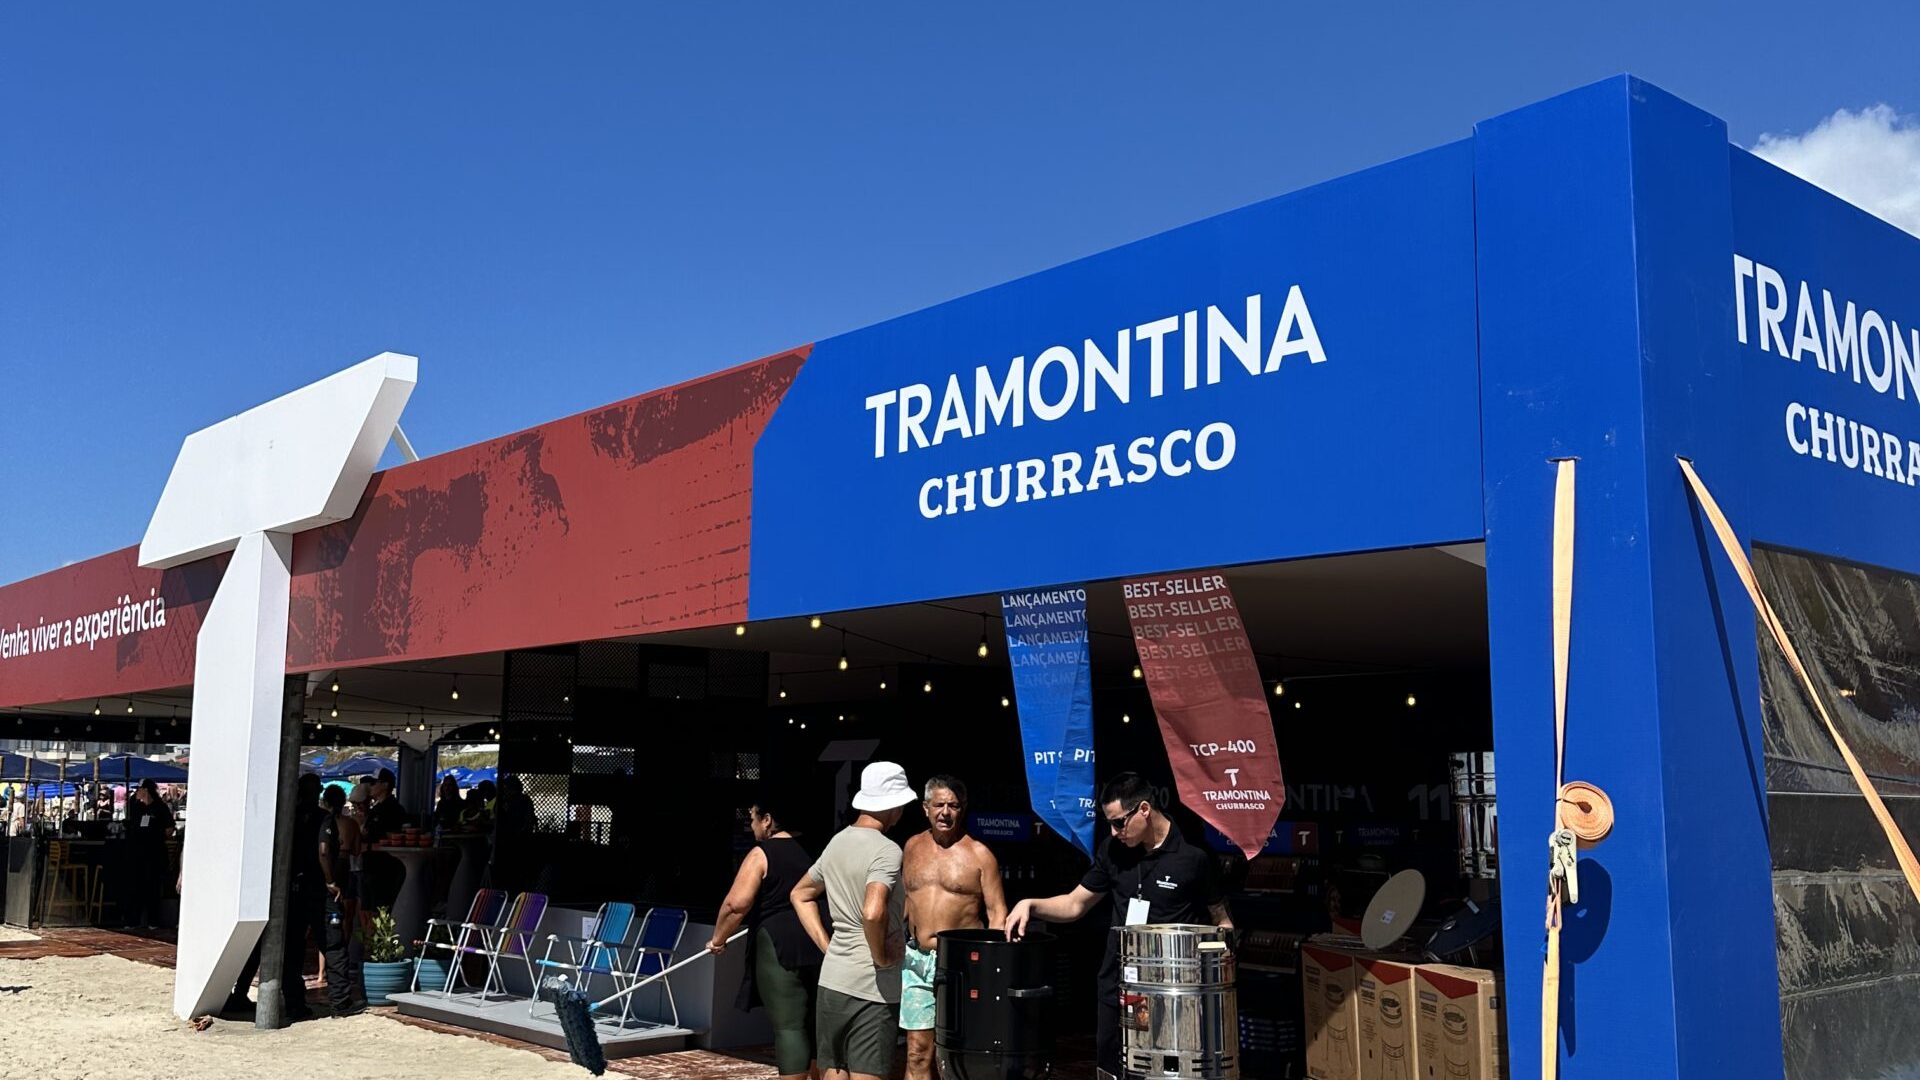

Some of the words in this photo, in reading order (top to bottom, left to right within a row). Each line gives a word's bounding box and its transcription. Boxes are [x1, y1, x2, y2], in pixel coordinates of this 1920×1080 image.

[865, 284, 1327, 459] TRAMONTINA
[918, 421, 1236, 519] CHURRASCO
[1123, 574, 1227, 599] BEST-SELLER
[1001, 588, 1086, 610] LANÇAMENTO
[1128, 595, 1234, 619] BEST-SELLER
[32, 616, 62, 652] viver
[63, 619, 72, 647] a
[74, 587, 166, 650] experiência
[1134, 615, 1241, 640] BEST-SELLER
[1140, 636, 1248, 660] BEST-SELLER
[1034, 751, 1056, 765] PIT
[1190, 740, 1256, 757] TCP-400
[1202, 790, 1271, 801] TRAMONTINA
